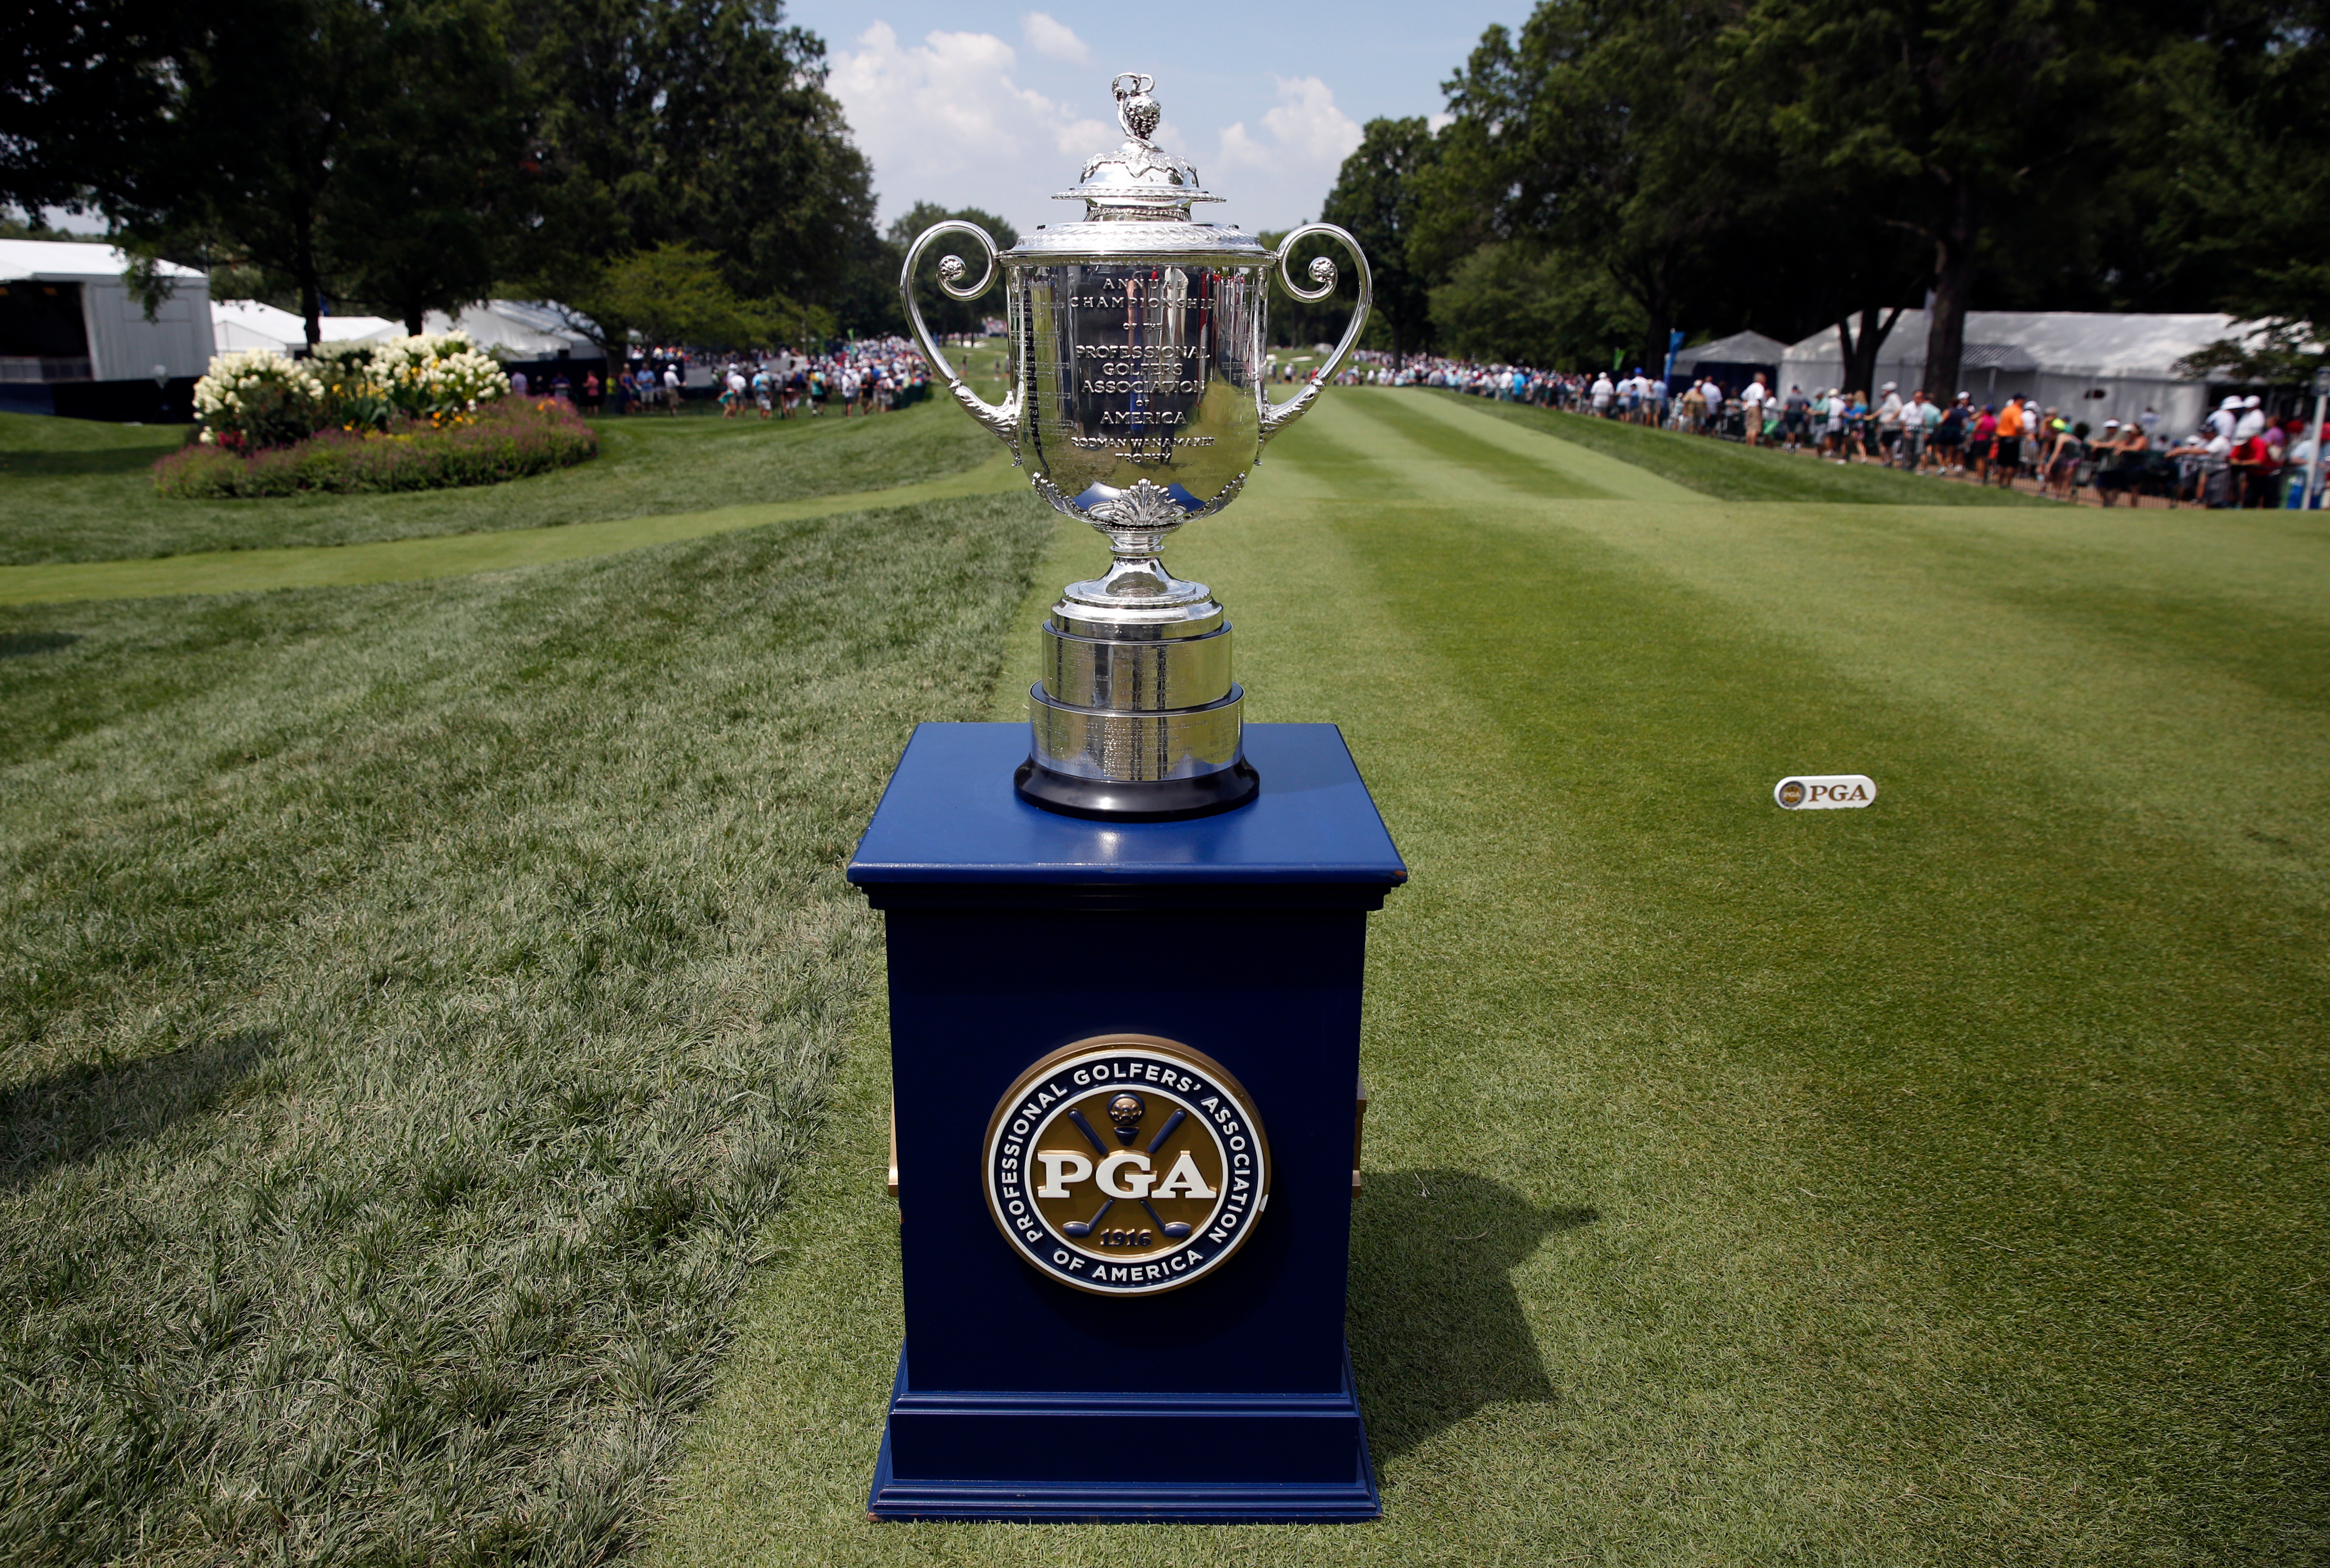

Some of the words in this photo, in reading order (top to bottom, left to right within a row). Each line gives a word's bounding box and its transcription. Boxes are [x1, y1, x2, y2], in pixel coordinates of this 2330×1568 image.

[1103, 278, 1186, 290] ANNUAL
[1070, 296, 1217, 310] CHAMPIONSHIP
[1143, 322, 1163, 331] THE
[1076, 345, 1210, 359] PROFESSIONAL
[1102, 362, 1183, 376] GOLFERS
[1081, 380, 1206, 393] ASSOCIATION
[1100, 411, 1187, 424] AMERICA
[1071, 436, 1127, 448] RODMAN
[1130, 436, 1216, 448] WANAMAKER
[1115, 452, 1172, 463] TROPHY
[1808, 784, 1869, 802] PGA
[1001, 1082, 1068, 1244] PROFESSIONAL
[1200, 1096, 1250, 1244] ASSOCIATION
[1037, 1150, 1217, 1199] PGA
[1100, 1228, 1152, 1247] 1916
[1053, 1249, 1086, 1271] OF
[1091, 1249, 1204, 1282] AMERICA
